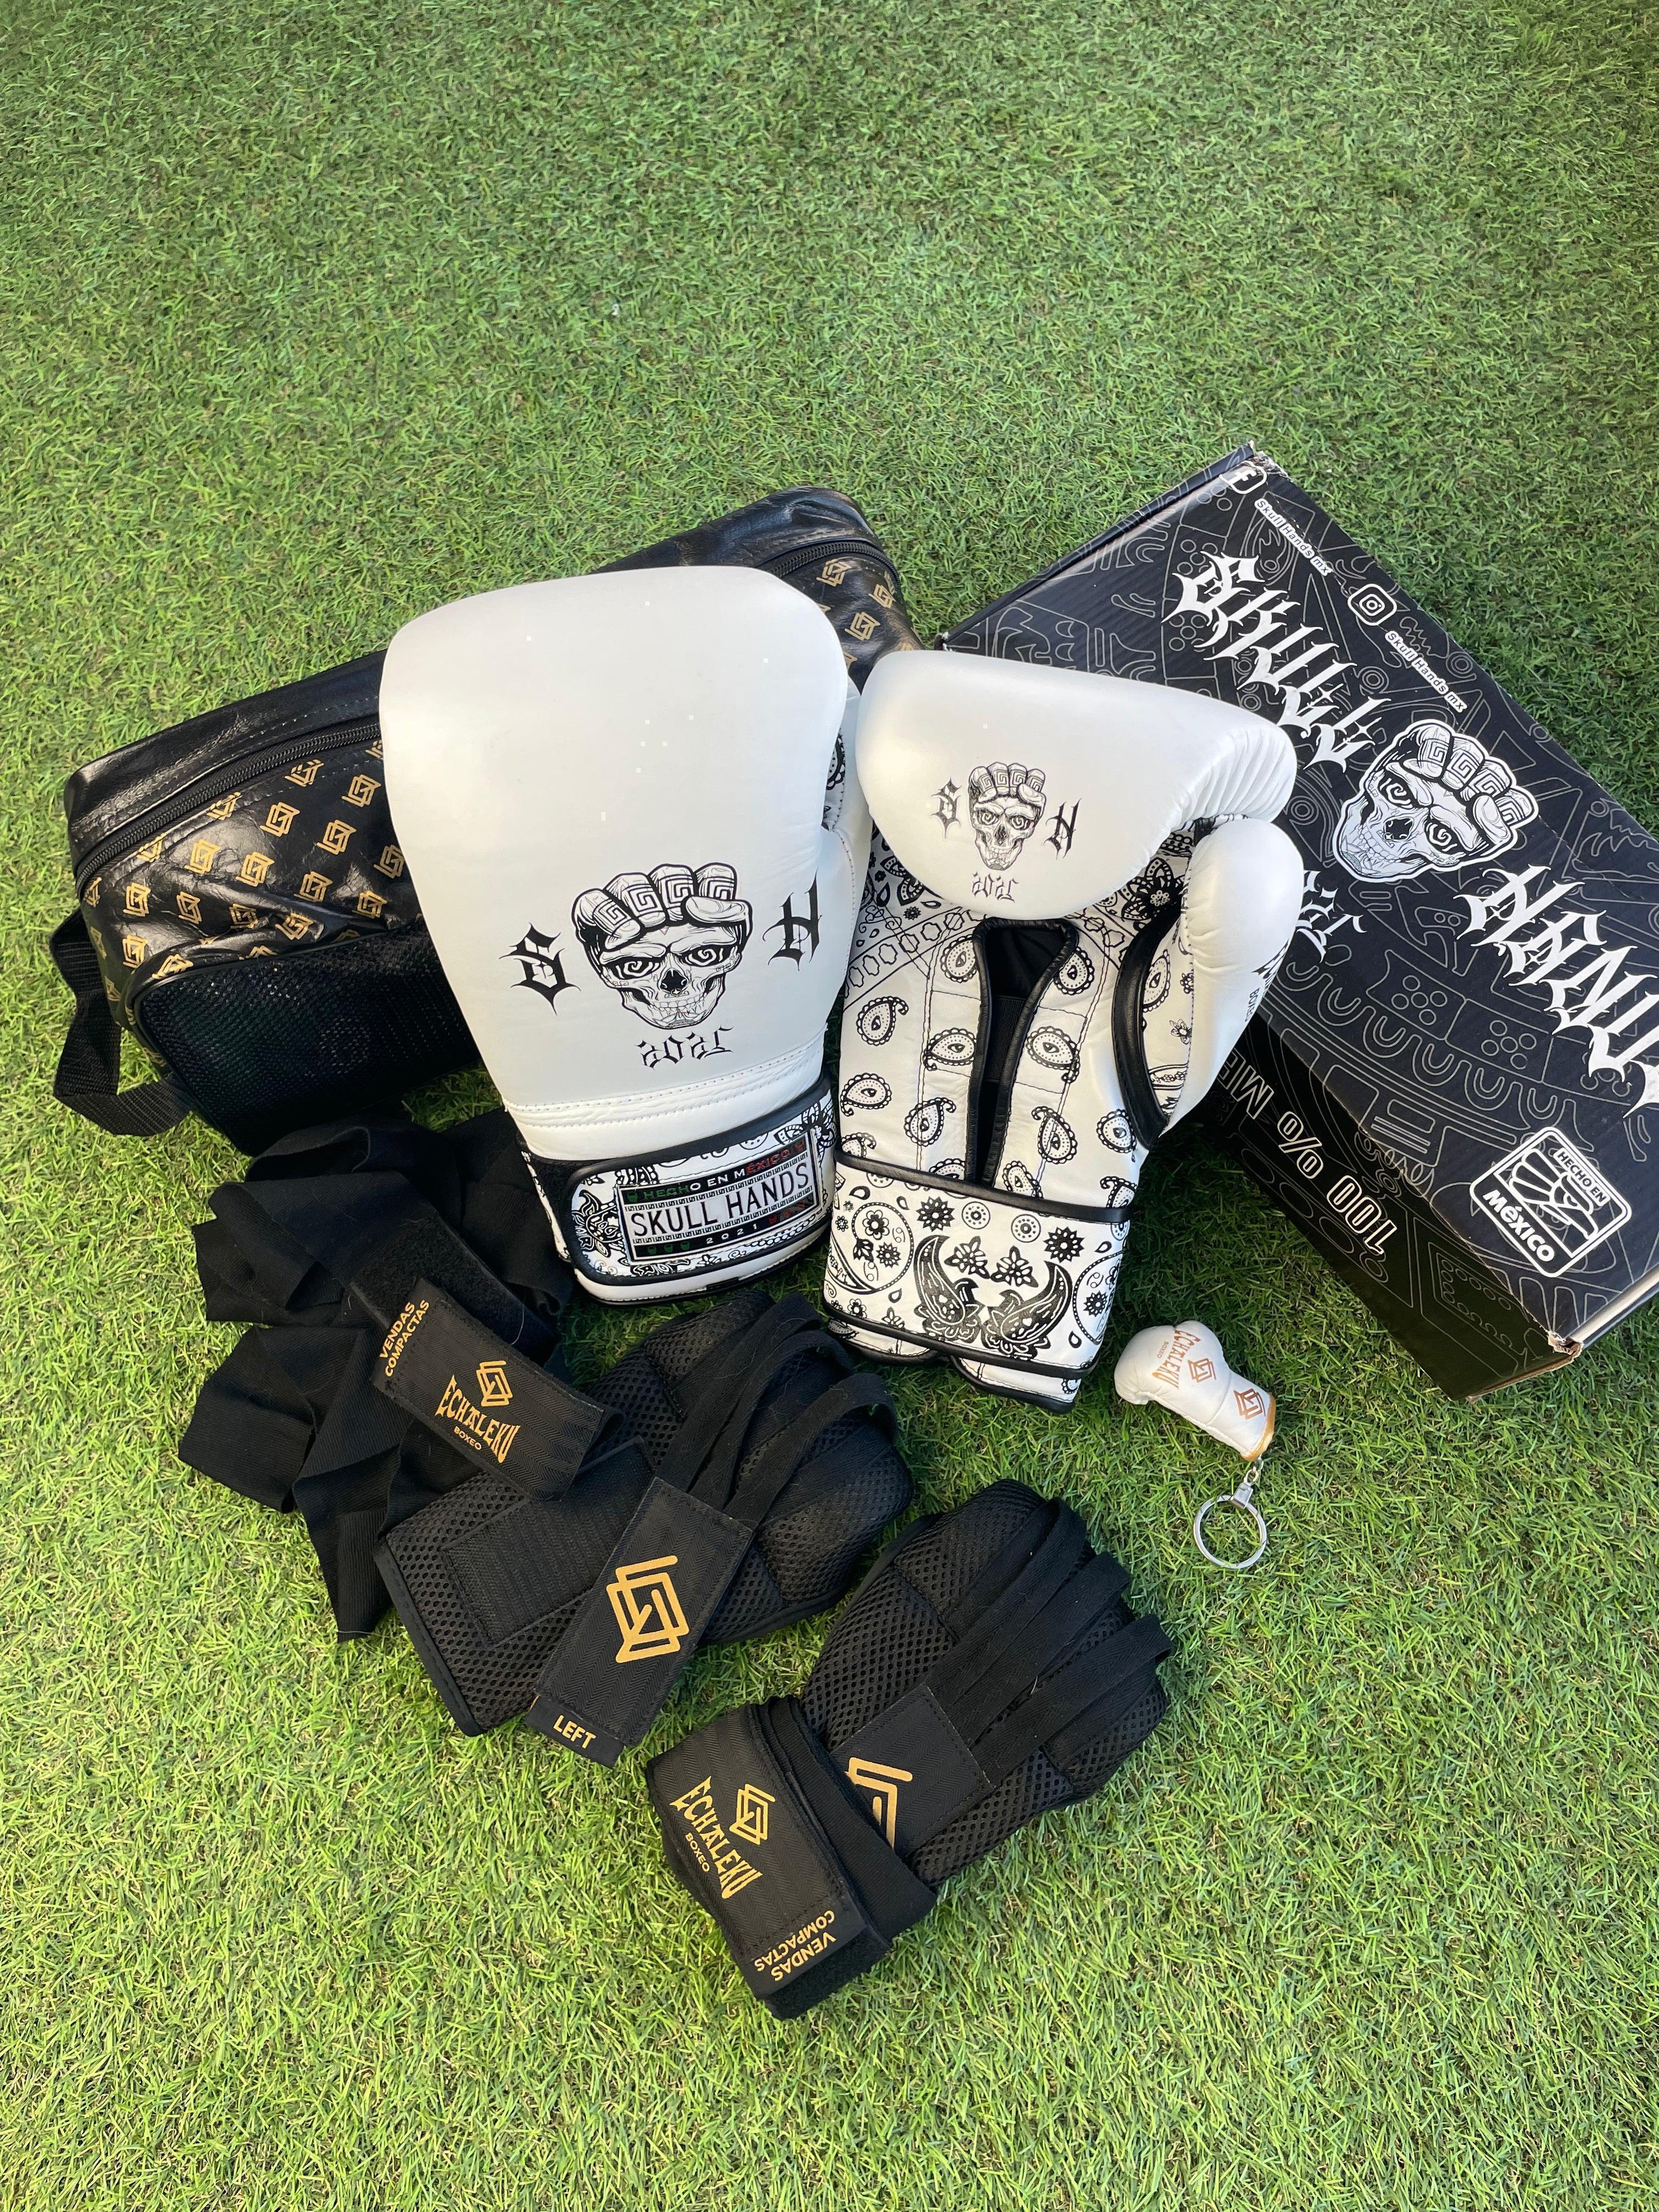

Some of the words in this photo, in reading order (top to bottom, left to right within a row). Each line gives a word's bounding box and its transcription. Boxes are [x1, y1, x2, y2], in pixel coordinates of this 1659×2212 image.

[1256, 500, 1285, 527] Skull
[1281, 525, 1313, 557] Hands
[1313, 558, 1330, 573] mx
[1387, 632, 1416, 660] Skull
[1413, 659, 1447, 693] Hands
[1447, 693, 1465, 710] mx
[1453, 864, 1659, 1118] HAND
[1277, 1111, 1323, 1179] %
[630, 1201, 718, 1237] SKULL
[725, 1162, 809, 1219] HANDS
[642, 1182, 701, 1200] HECHO
[707, 1174, 729, 1188] EN
[1557, 1151, 1593, 1187] HECHO
[1588, 1187, 1607, 1203] EN
[1326, 1175, 1397, 1254] 100
[379, 1302, 415, 1359] VENDAS
[385, 1299, 430, 1376] COMPACTAS
[1157, 1341, 1169, 1358] BOXEO
[454, 1426, 482, 1451] BOXEO
[553, 1714, 596, 1750] LEFT
[685, 1832, 710, 1872] BOXEO
[754, 1910, 836, 1972] COMPACTAS
[770, 1932, 837, 1982] VENDAS
